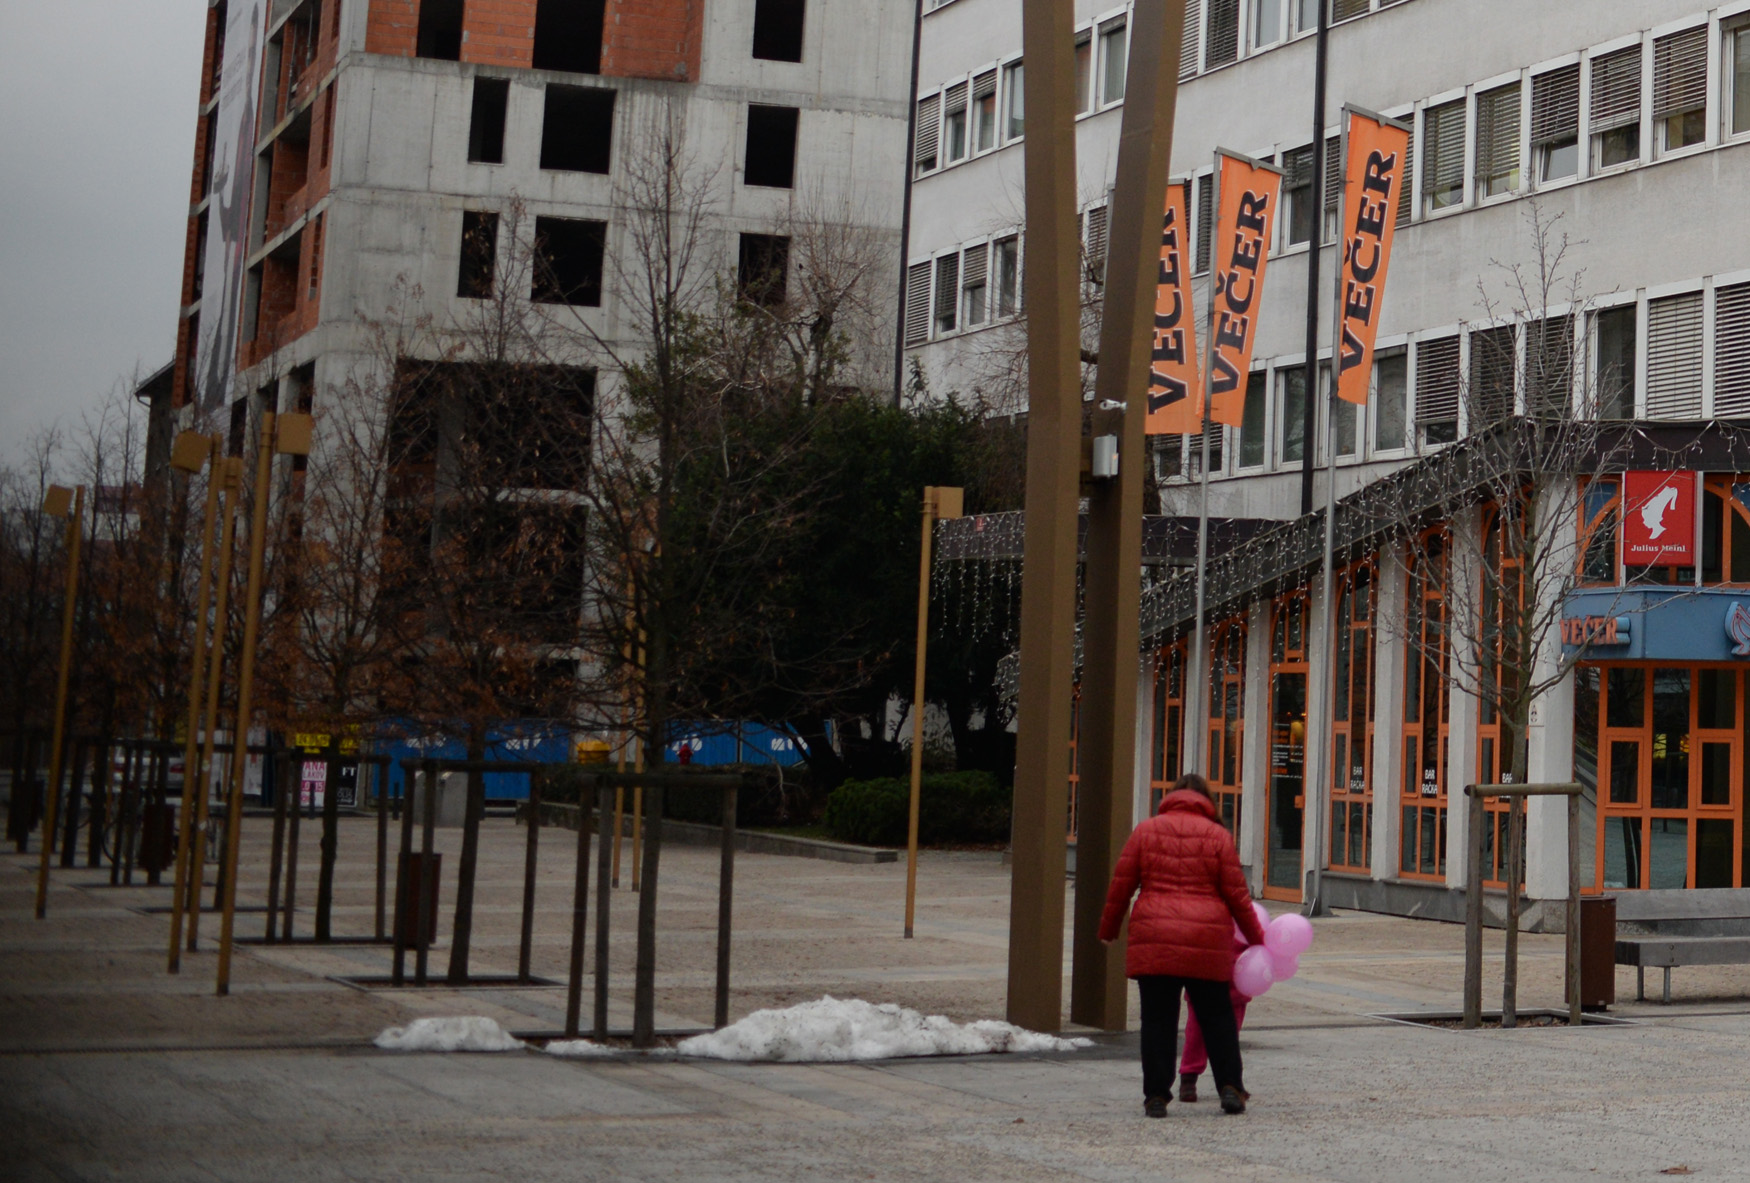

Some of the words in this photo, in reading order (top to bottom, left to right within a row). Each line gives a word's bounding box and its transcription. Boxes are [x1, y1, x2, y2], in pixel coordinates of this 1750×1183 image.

[1340, 149, 1397, 376] VEČER
[1211, 189, 1270, 395] VEČER
[1631, 544, 1659, 552] Julius
[1661, 544, 1686, 552] Meinl
[1559, 614, 1618, 645] VEČER
[1424, 769, 1436, 779] BAR
[1421, 781, 1438, 795] RAČKA
